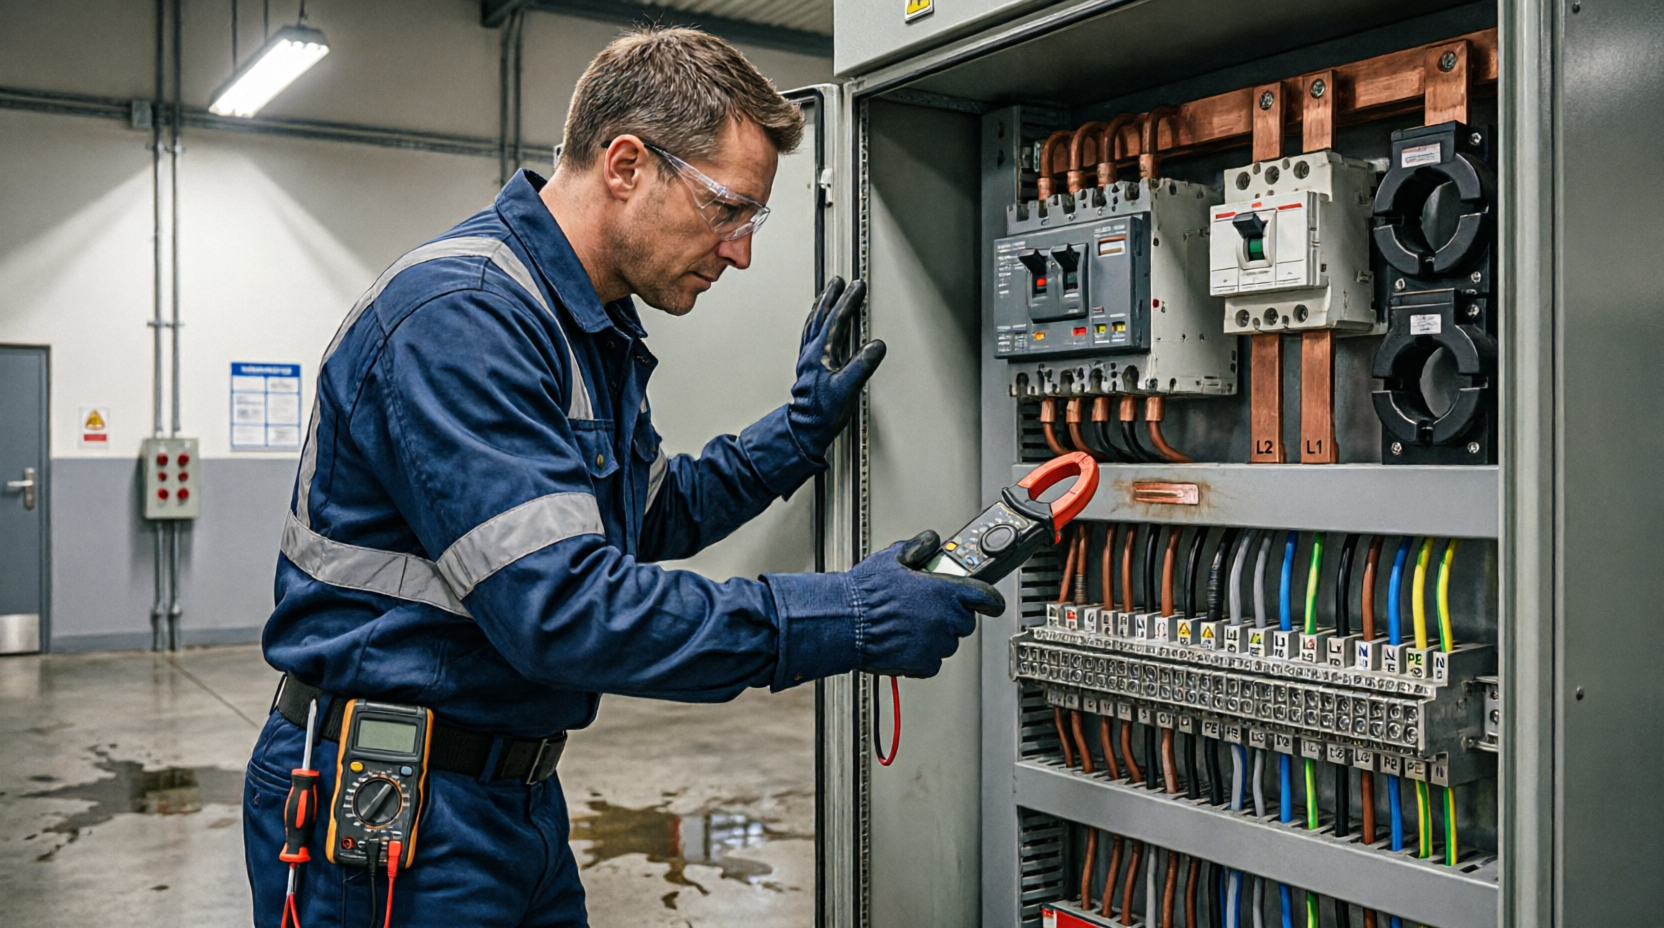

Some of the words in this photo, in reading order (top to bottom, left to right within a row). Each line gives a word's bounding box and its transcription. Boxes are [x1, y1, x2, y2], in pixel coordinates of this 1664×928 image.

[1256, 440, 1273, 454] L2
[1306, 440, 1322, 454] L1
[1408, 652, 1422, 666] PE
[1204, 722, 1217, 734] PE
[1407, 762, 1424, 775] PE
